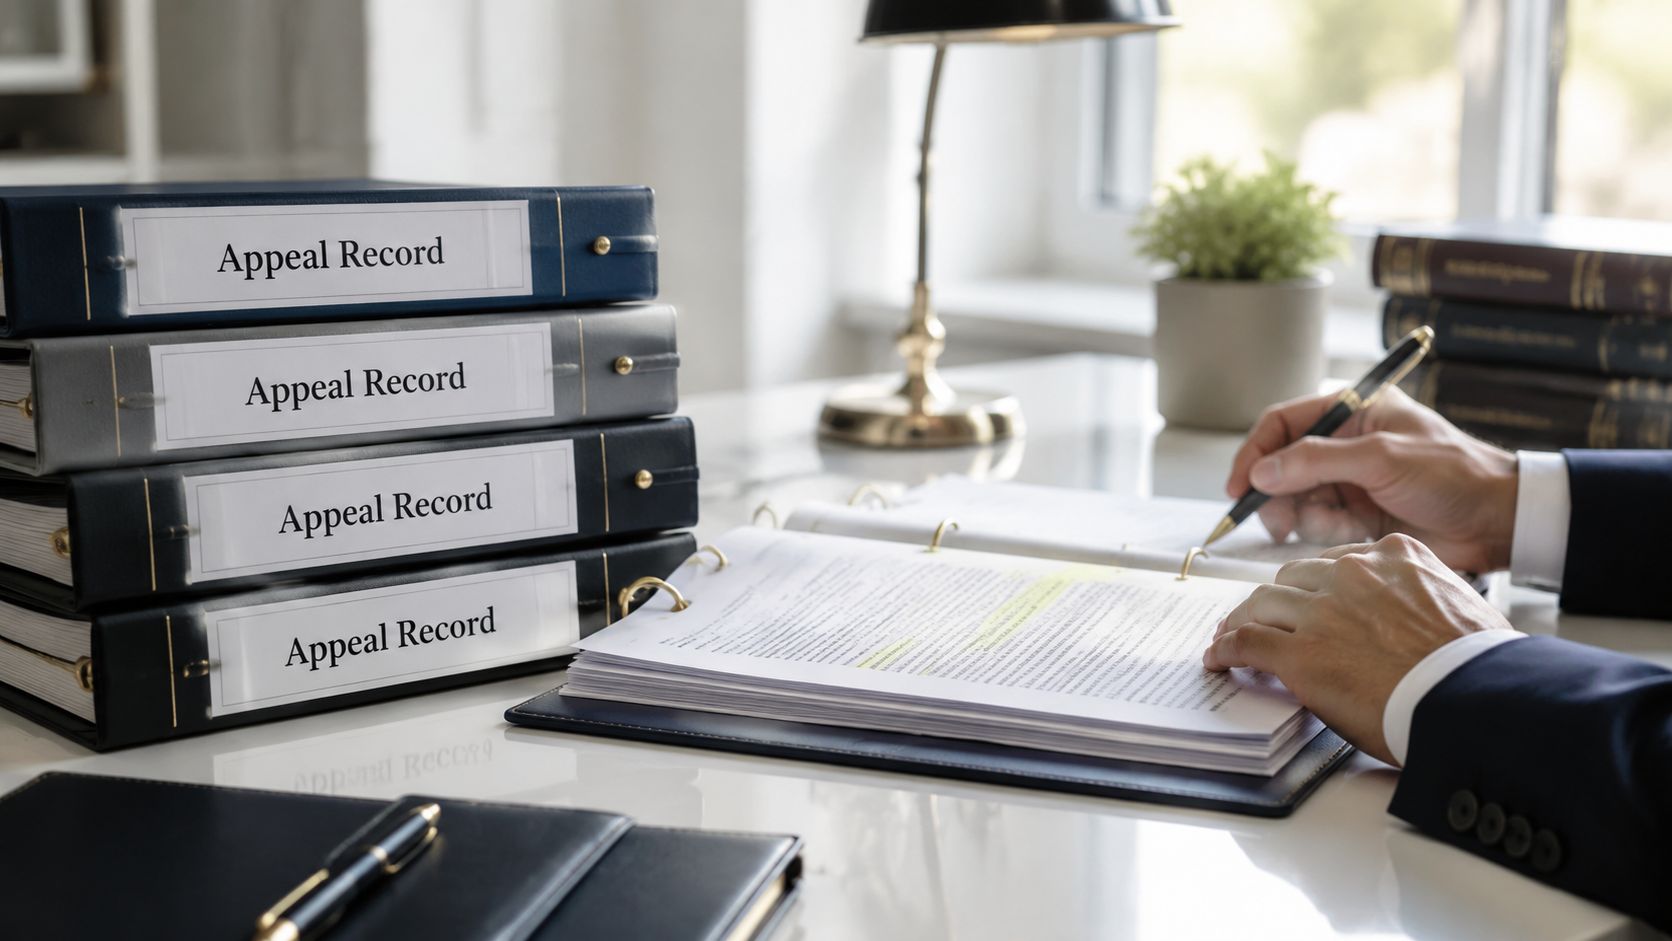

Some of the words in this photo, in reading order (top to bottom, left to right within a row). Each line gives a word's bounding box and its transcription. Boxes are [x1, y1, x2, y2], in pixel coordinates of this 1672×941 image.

[216, 239, 330, 281] Appeal
[337, 235, 446, 269] Record
[244, 368, 355, 413] Appeal
[362, 362, 467, 396] Record
[278, 493, 385, 540] Appeal
[391, 482, 493, 520] Record
[285, 623, 389, 672] Appeal
[396, 606, 497, 648] Record
